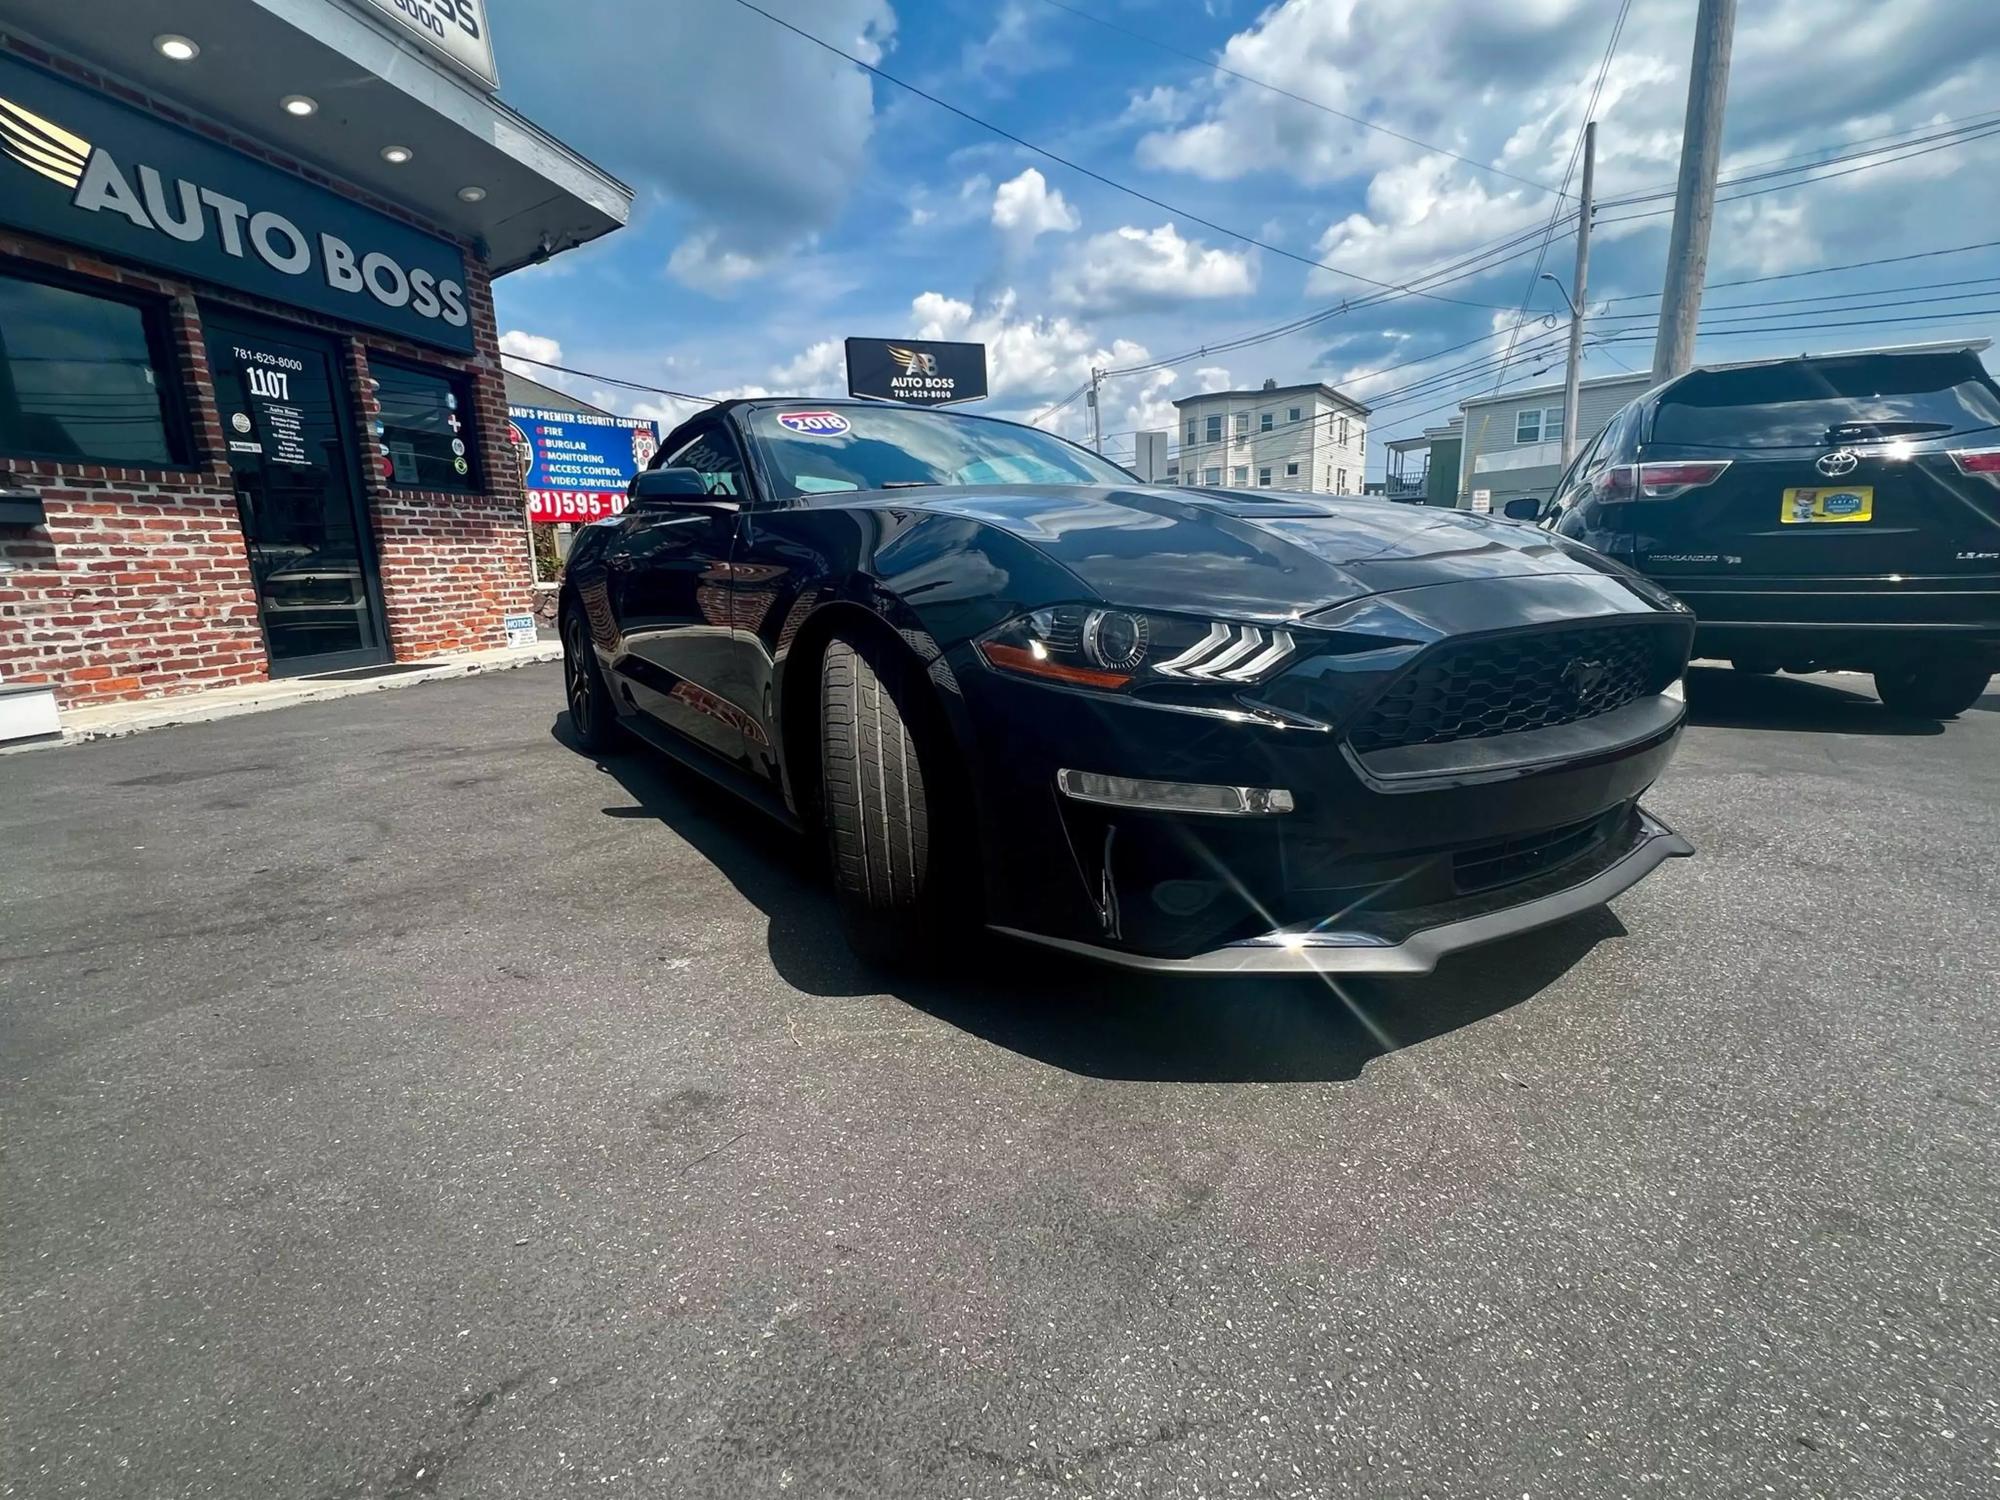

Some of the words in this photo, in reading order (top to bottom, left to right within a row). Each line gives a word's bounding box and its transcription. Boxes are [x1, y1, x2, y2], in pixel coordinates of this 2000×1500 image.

[72, 147, 311, 276] AUTO
[320, 231, 468, 327] BOSS
[232, 346, 302, 371] 781-629-8000
[246, 366, 289, 400] 1107
[890, 376, 923, 388] AUTO
[925, 378, 955, 389] BOSS
[894, 389, 952, 398] 781-629-8000
[536, 410, 576, 424] PREMIER
[576, 414, 615, 427] SECURITY
[616, 418, 652, 430] COMPANY
[788, 415, 846, 431] 2018
[543, 426, 564, 437] FIRE
[545, 438, 587, 451] BURGLAR
[547, 451, 605, 464] MONITORING
[549, 463, 582, 475] ACCESS
[582, 466, 623, 477] CONTROL
[550, 475, 578, 486] VIDEO
